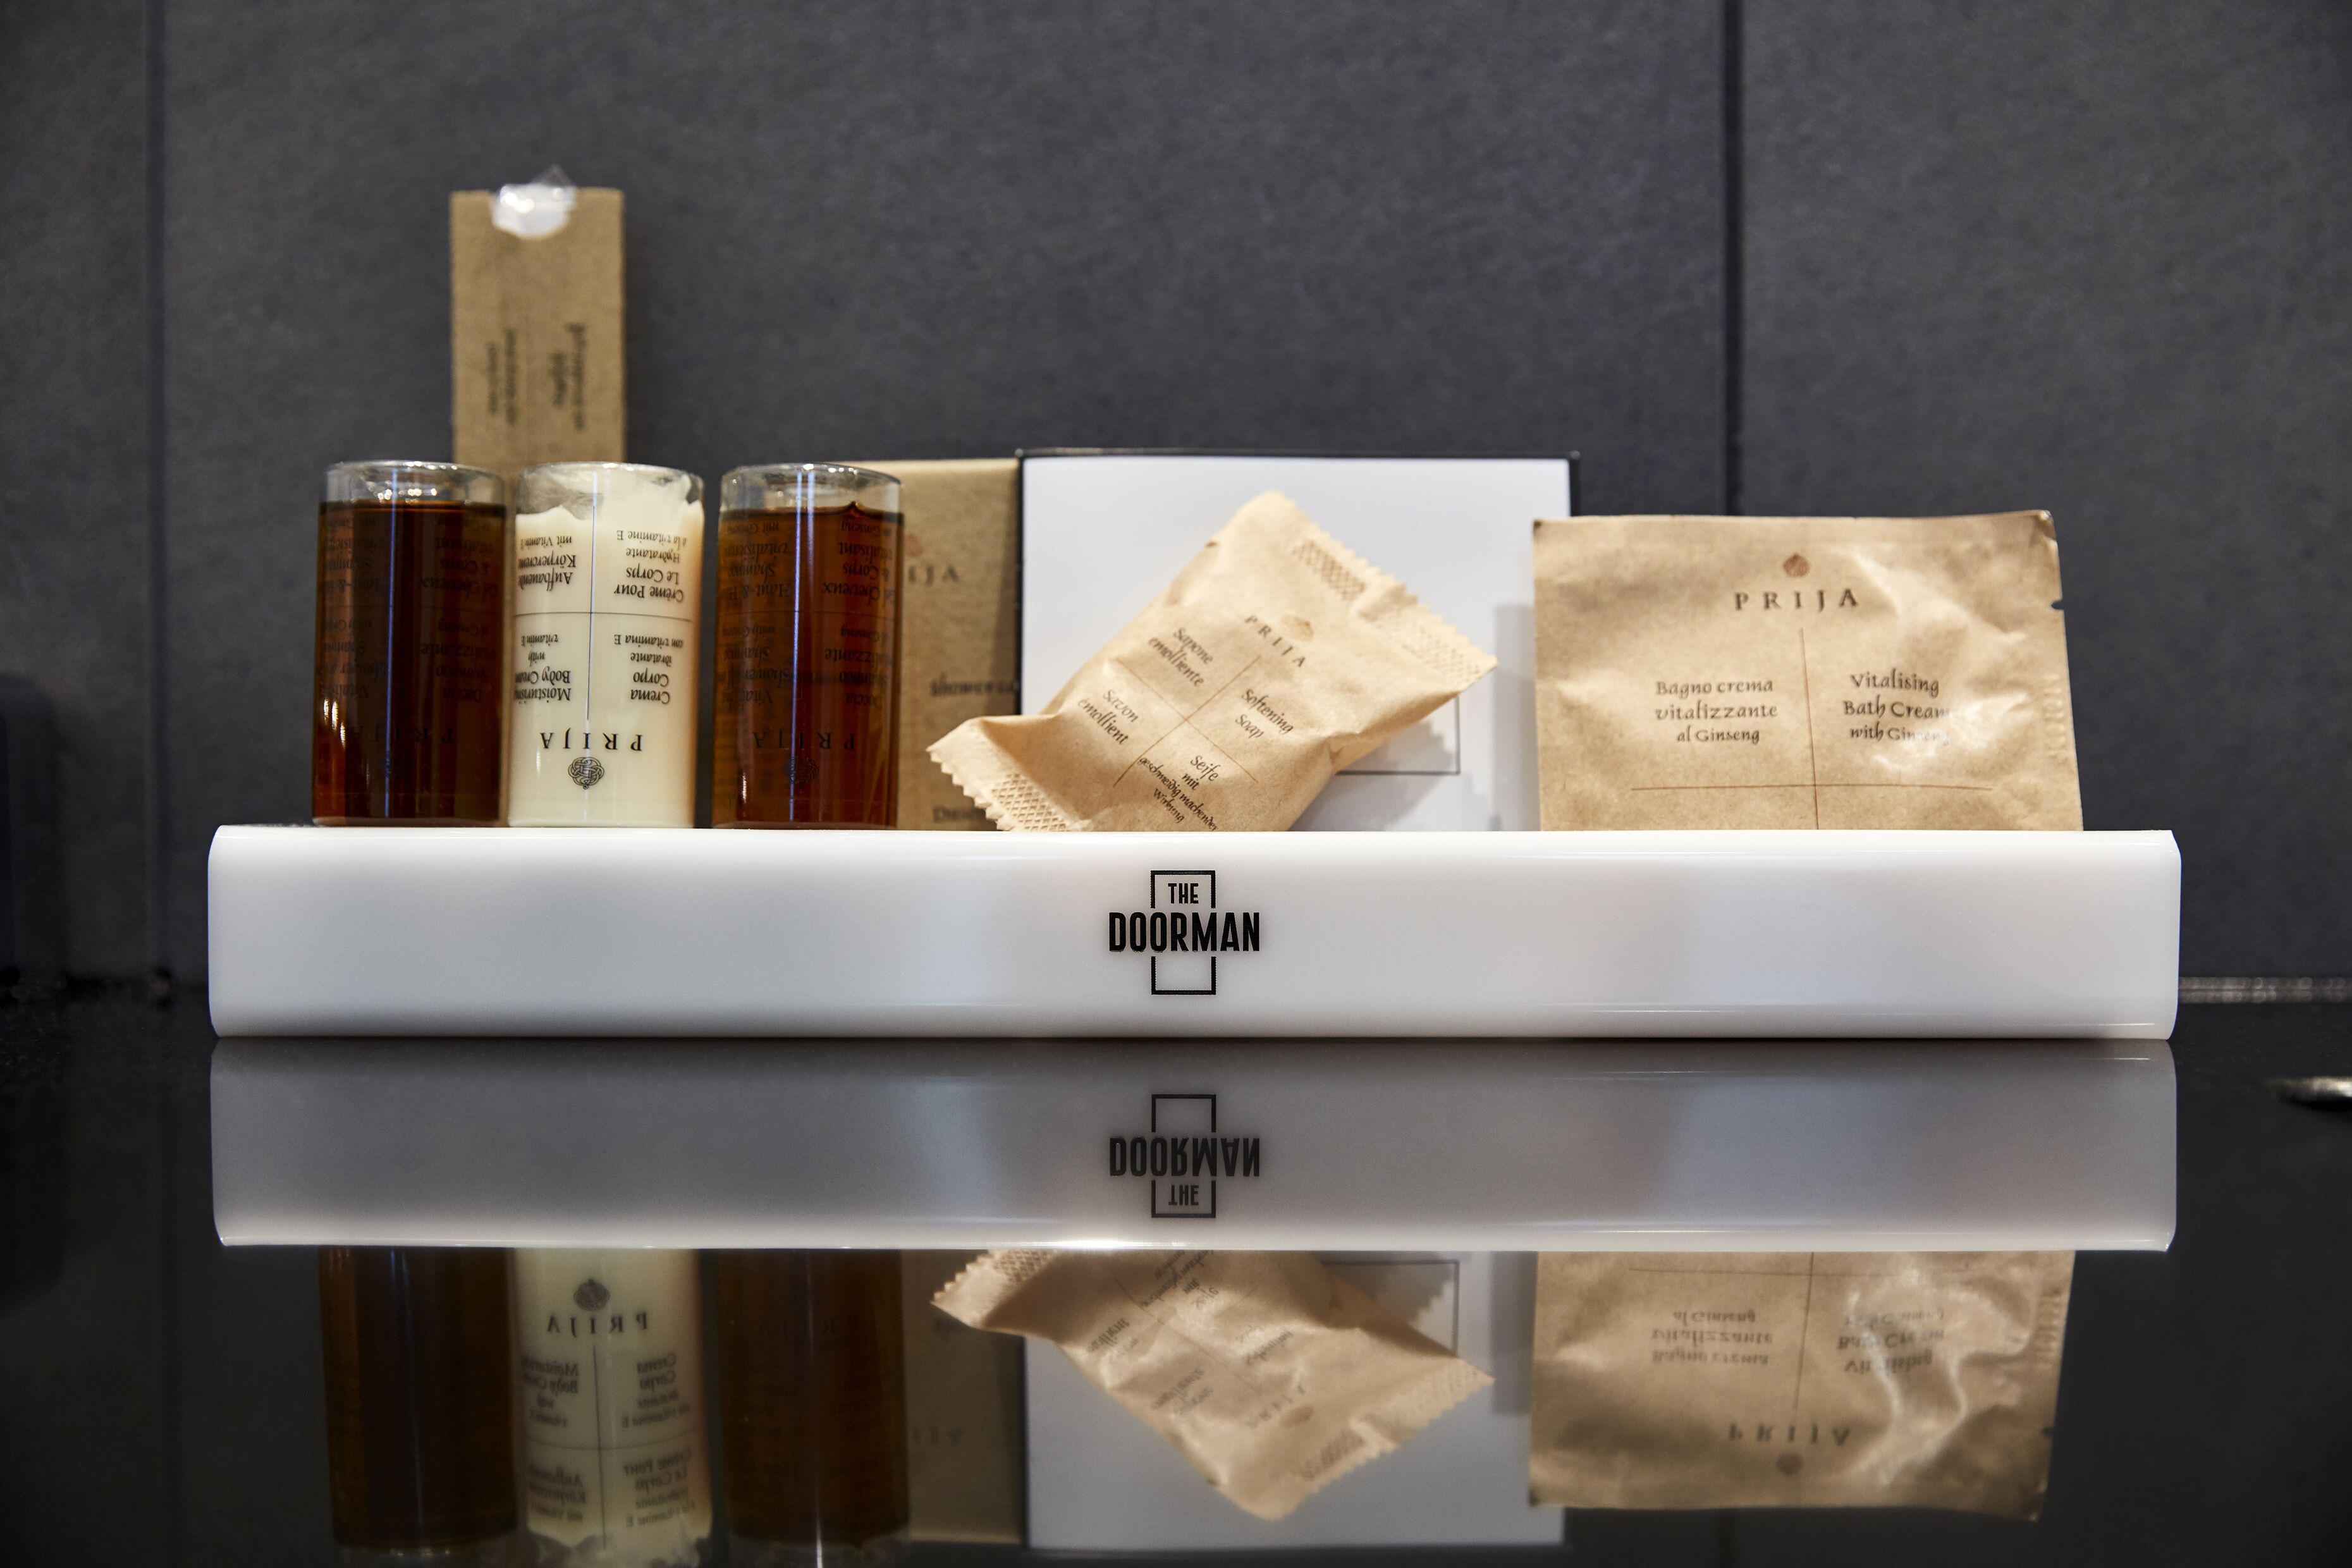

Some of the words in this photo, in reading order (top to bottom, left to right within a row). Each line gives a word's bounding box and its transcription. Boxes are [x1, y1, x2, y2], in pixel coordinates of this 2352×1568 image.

[525, 536, 553, 550] Vitamin
[556, 536, 572, 548] mit
[616, 529, 623, 541] E
[625, 529, 671, 546] vitamine
[626, 548, 681, 564] Hydratante
[626, 563, 664, 583] Corps
[666, 571, 680, 585] Le
[842, 559, 879, 580] Corps
[909, 565, 960, 587] IJA
[613, 584, 646, 599] Pour
[649, 586, 684, 604] Crème
[1734, 588, 1859, 612] PRIJA
[614, 634, 622, 645] E
[625, 634, 670, 650] vitamina
[1173, 627, 1214, 665] Sapone
[1244, 615, 1307, 668] PRIJA
[528, 651, 546, 668] with
[630, 652, 672, 667] idratante
[1147, 637, 1205, 687] emolliente
[541, 666, 571, 686] Body
[633, 668, 670, 687] Corpo
[1850, 667, 1939, 698] Vitalising
[630, 689, 670, 705] Crema
[1655, 680, 1712, 699] Bagno
[1717, 679, 1774, 694] crema
[846, 693, 883, 709] Doccia
[1102, 689, 1139, 723] Savon
[1655, 699, 1779, 721] vitalizzante
[1842, 694, 1886, 718] Bath
[1890, 701, 1950, 719] Cream
[1241, 689, 1294, 735] Softening
[1235, 713, 1265, 739] Soap
[1676, 725, 1692, 743] al
[1695, 727, 1760, 744] Ginseng
[1850, 721, 1884, 742] with
[539, 727, 642, 752] PRIJA
[753, 728, 856, 750] PRIJA
[1190, 755, 1221, 782] Seife
[1181, 773, 1200, 791] mit
[1139, 757, 1182, 799] geschmeidig
[1179, 793, 1218, 831] machender
[1153, 788, 1185, 824] Wirkung
[1168, 883, 1199, 904] THE
[1109, 912, 1260, 952] DOORMAN
